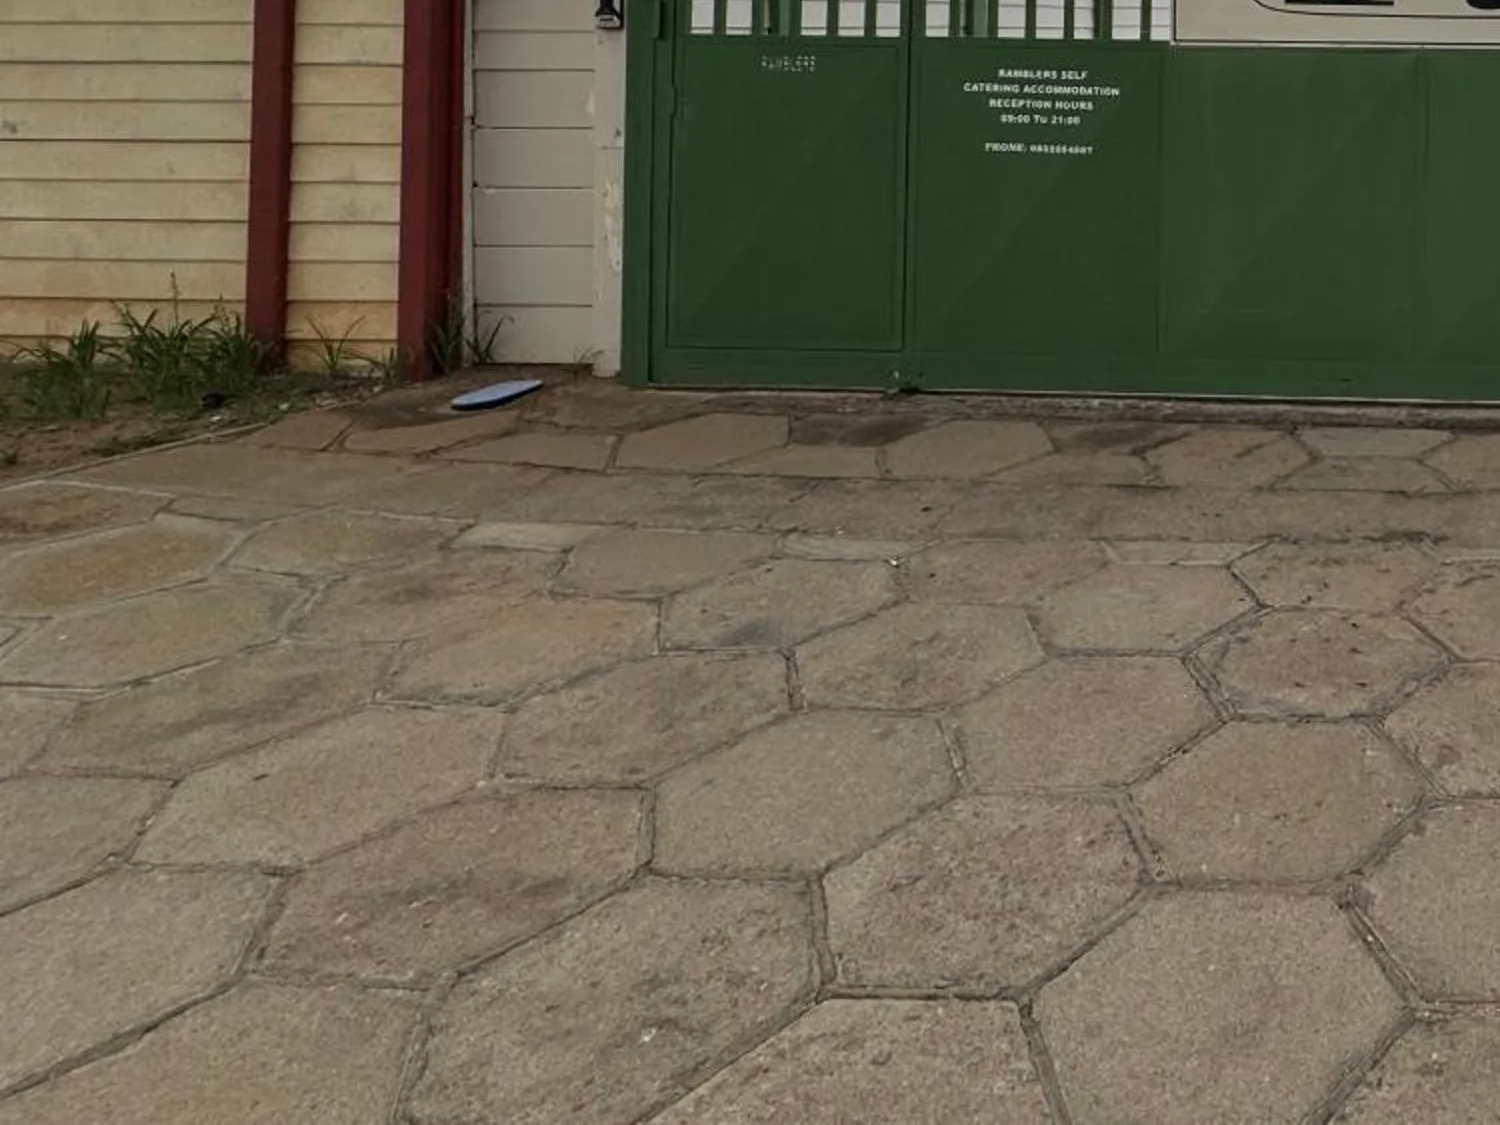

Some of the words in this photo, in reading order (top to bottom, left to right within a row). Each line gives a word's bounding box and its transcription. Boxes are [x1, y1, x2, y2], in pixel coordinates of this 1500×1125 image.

[998, 69, 1057, 79] RAMBLERS
[1061, 70, 1088, 80] SELF
[963, 82, 1019, 93] CATERING
[1023, 84, 1120, 96] ACCOMMODATION
[989, 98, 1052, 109] RECEPTION
[1055, 100, 1093, 110] HOURS
